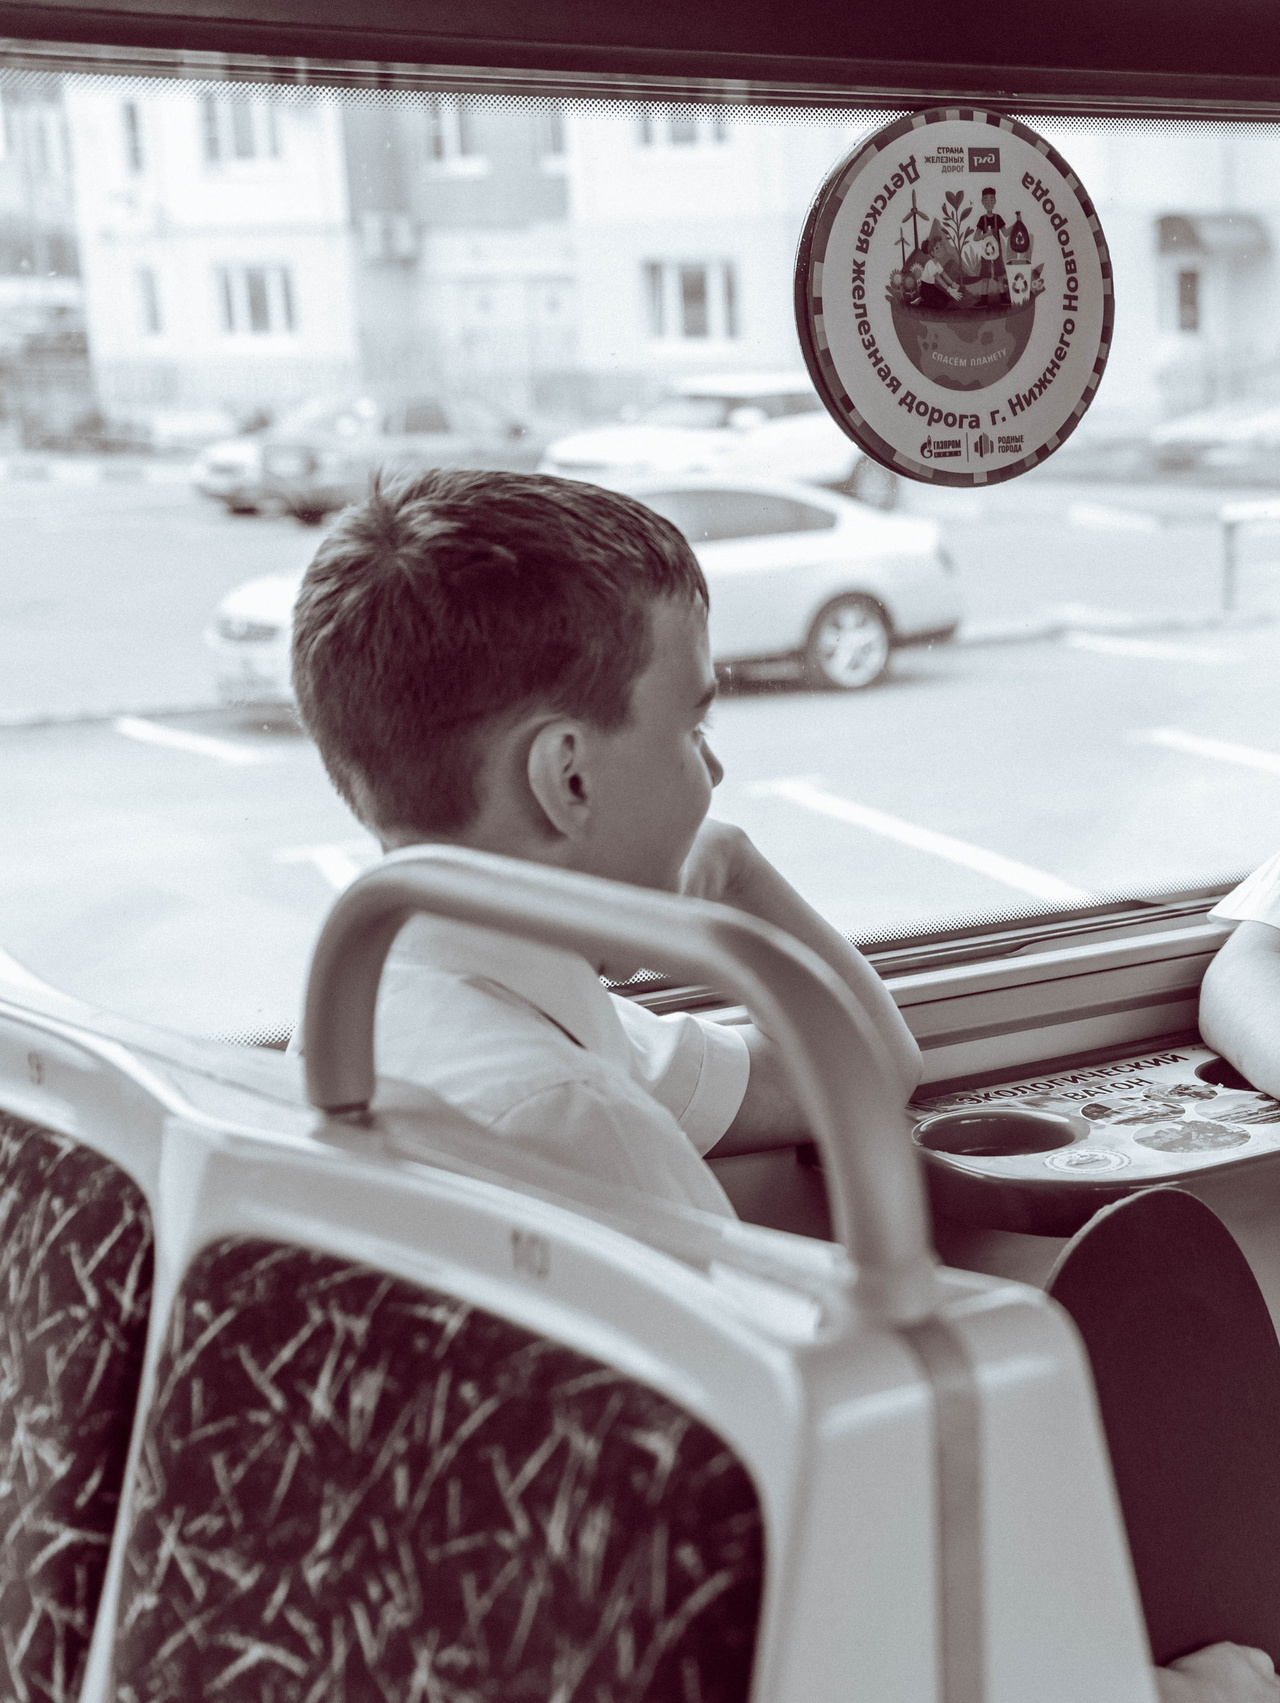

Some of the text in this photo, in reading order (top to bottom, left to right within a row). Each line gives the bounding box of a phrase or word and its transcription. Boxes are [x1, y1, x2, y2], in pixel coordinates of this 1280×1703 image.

[937, 146, 964, 154] СТРАНА
[924, 156, 965, 164] ЖЕЛЕЗНЫХ
[941, 165, 965, 174] ДОРОГ
[852, 154, 1079, 430] Детская железная дорога г. Нижнего Новгорода
[932, 347, 1008, 367] СПАСЁМ ПЛАНЕТУ
[933, 440, 962, 450] ГАЗПРОМ
[998, 435, 1024, 445] РОДНЫЕ
[998, 444, 1022, 454] ГОРОДА
[957, 1053, 1189, 1105] ЭКОЛОГИЧЕСКИЙ
[1061, 1077, 1155, 1101] ВАГОН
